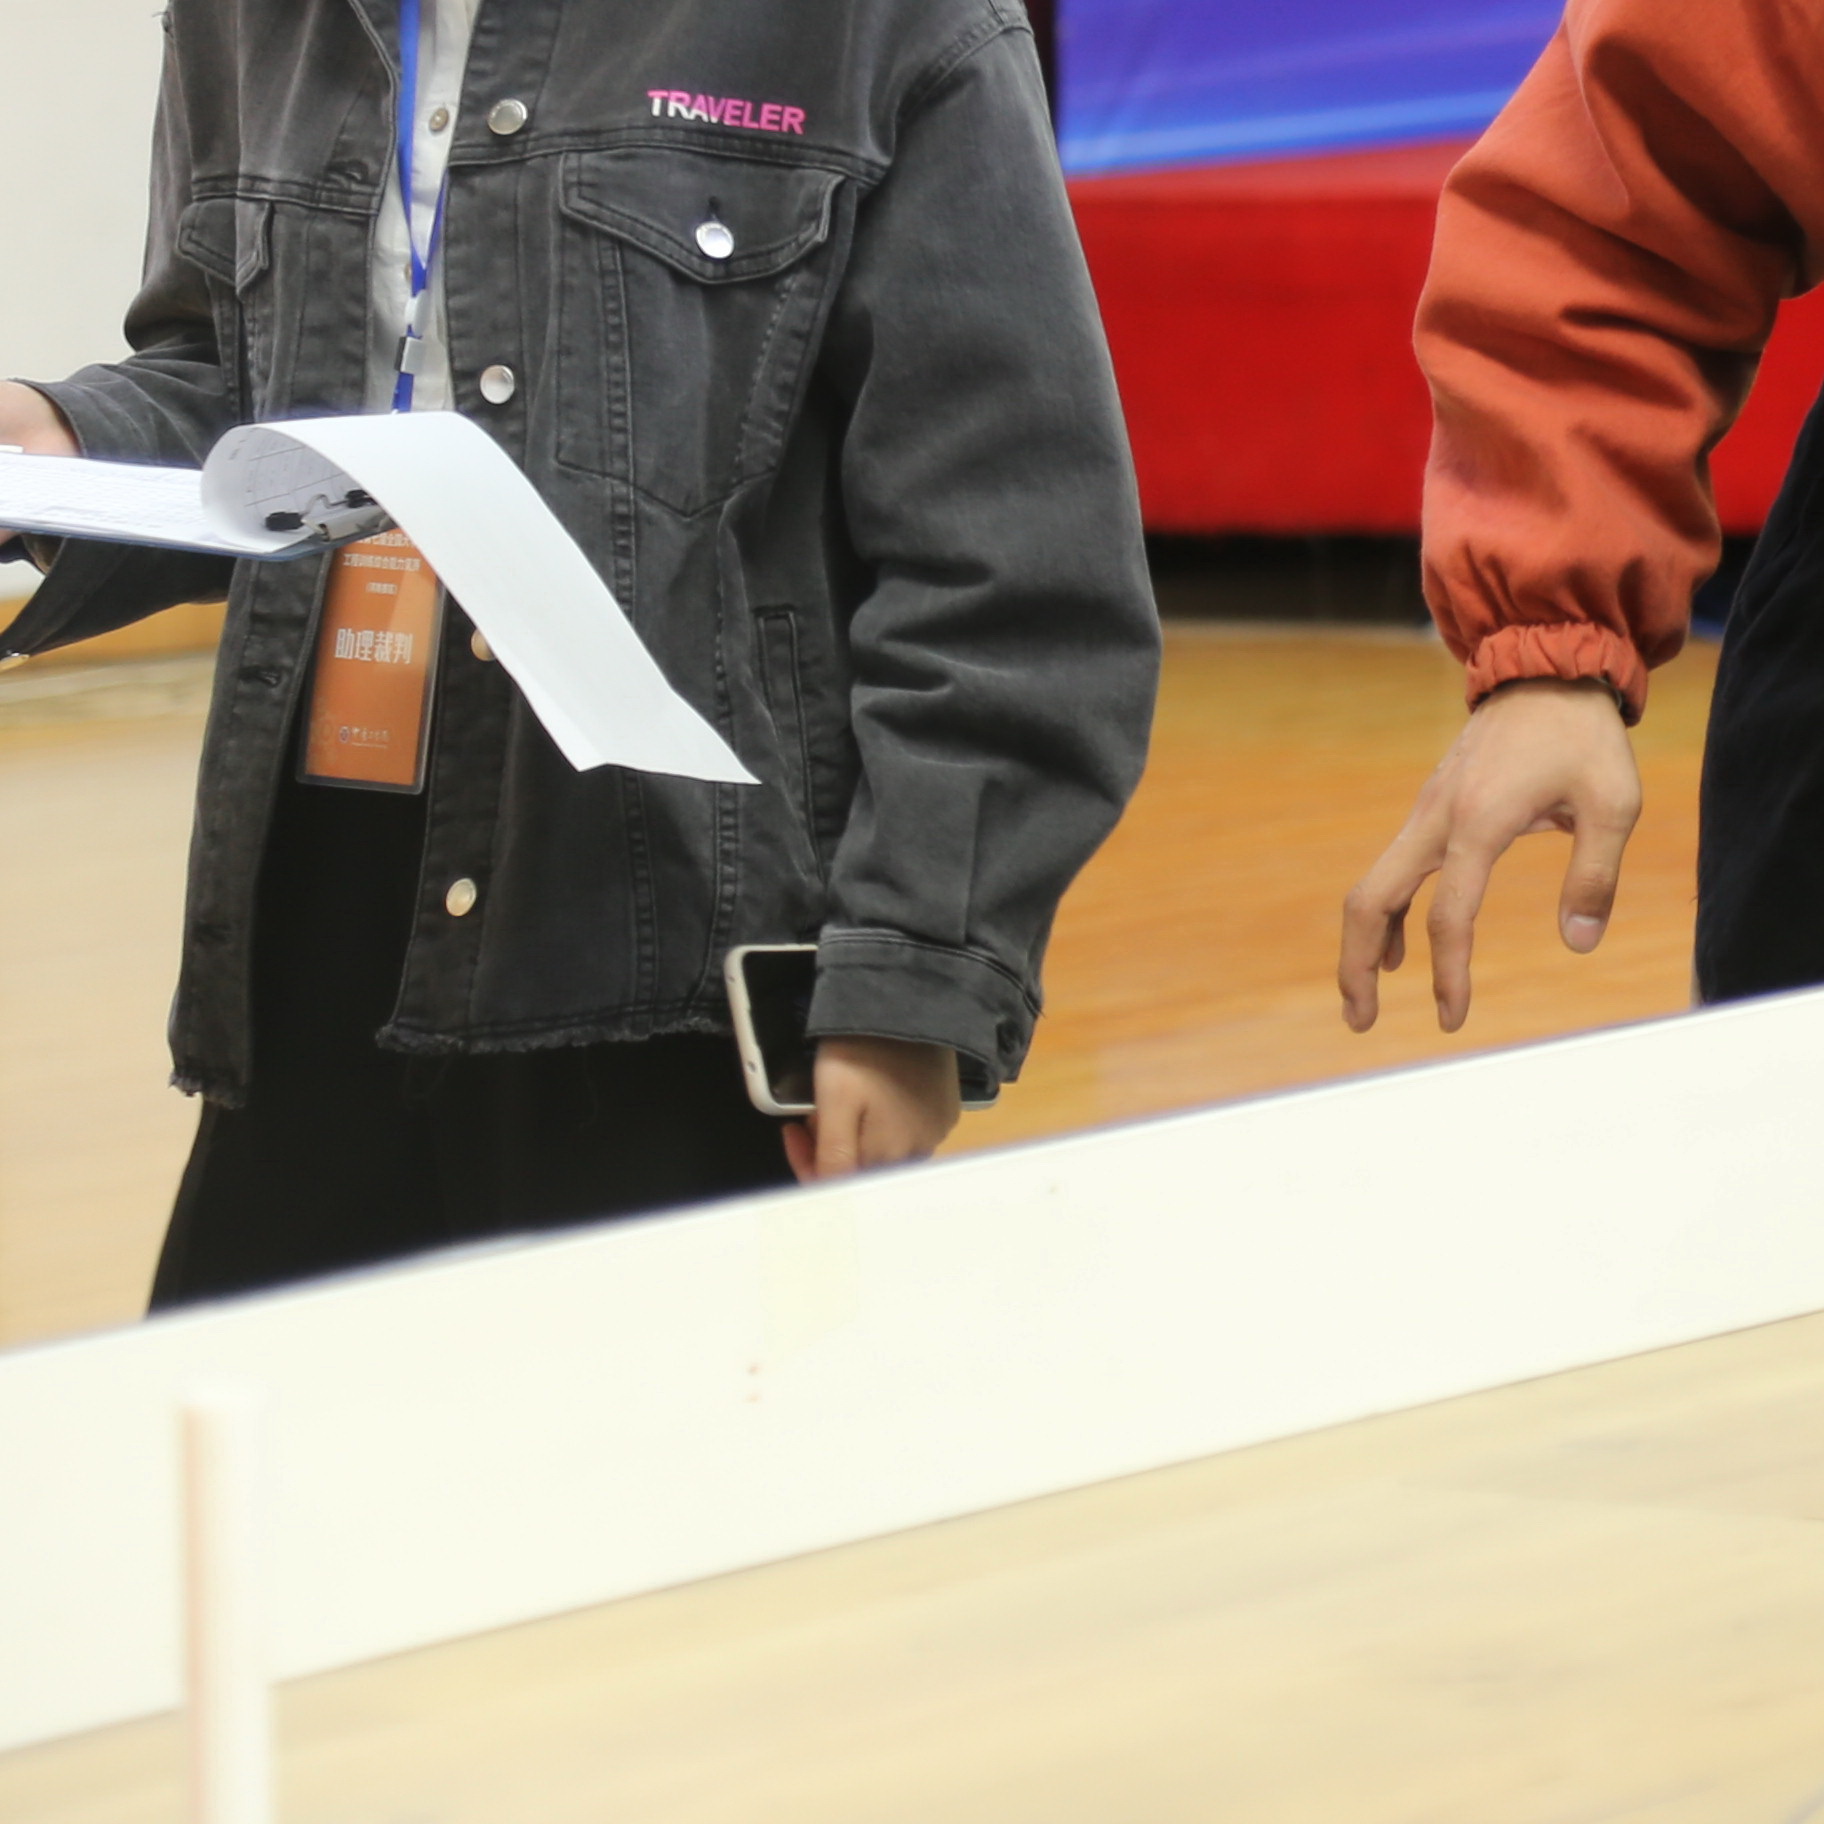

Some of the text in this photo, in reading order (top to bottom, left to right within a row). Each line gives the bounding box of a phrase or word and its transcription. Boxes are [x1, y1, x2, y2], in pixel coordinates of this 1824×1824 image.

[647, 89, 806, 135] TRAVELER
[334, 628, 413, 664] 助理裁判
